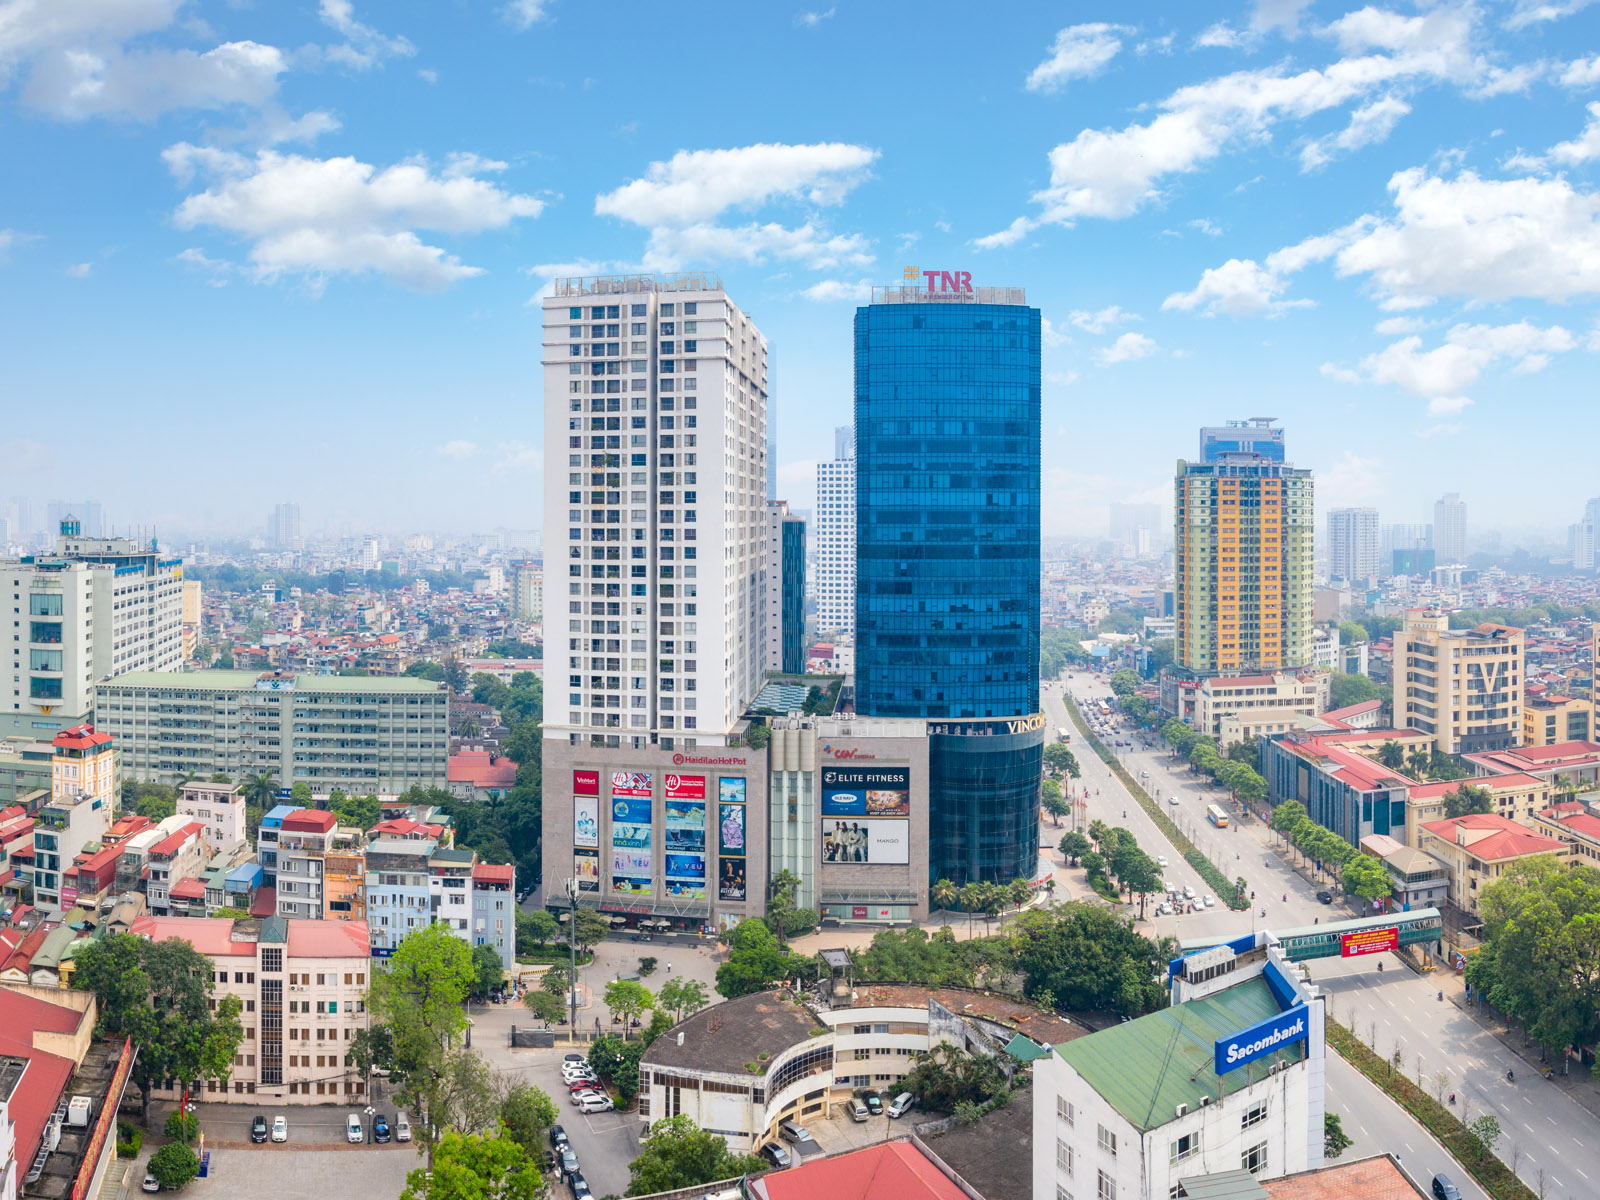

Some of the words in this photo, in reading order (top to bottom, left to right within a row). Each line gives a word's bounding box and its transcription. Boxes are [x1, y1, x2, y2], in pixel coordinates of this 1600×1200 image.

[923, 271, 973, 292] TNR
[834, 749, 855, 759] CGV
[685, 756, 718, 765] Haidilao
[718, 757, 732, 765] Hot
[733, 757, 746, 765] Pot
[838, 774, 863, 782] ELITE
[866, 774, 904, 782] FITNESS
[1226, 1018, 1304, 1063] Sacombank
